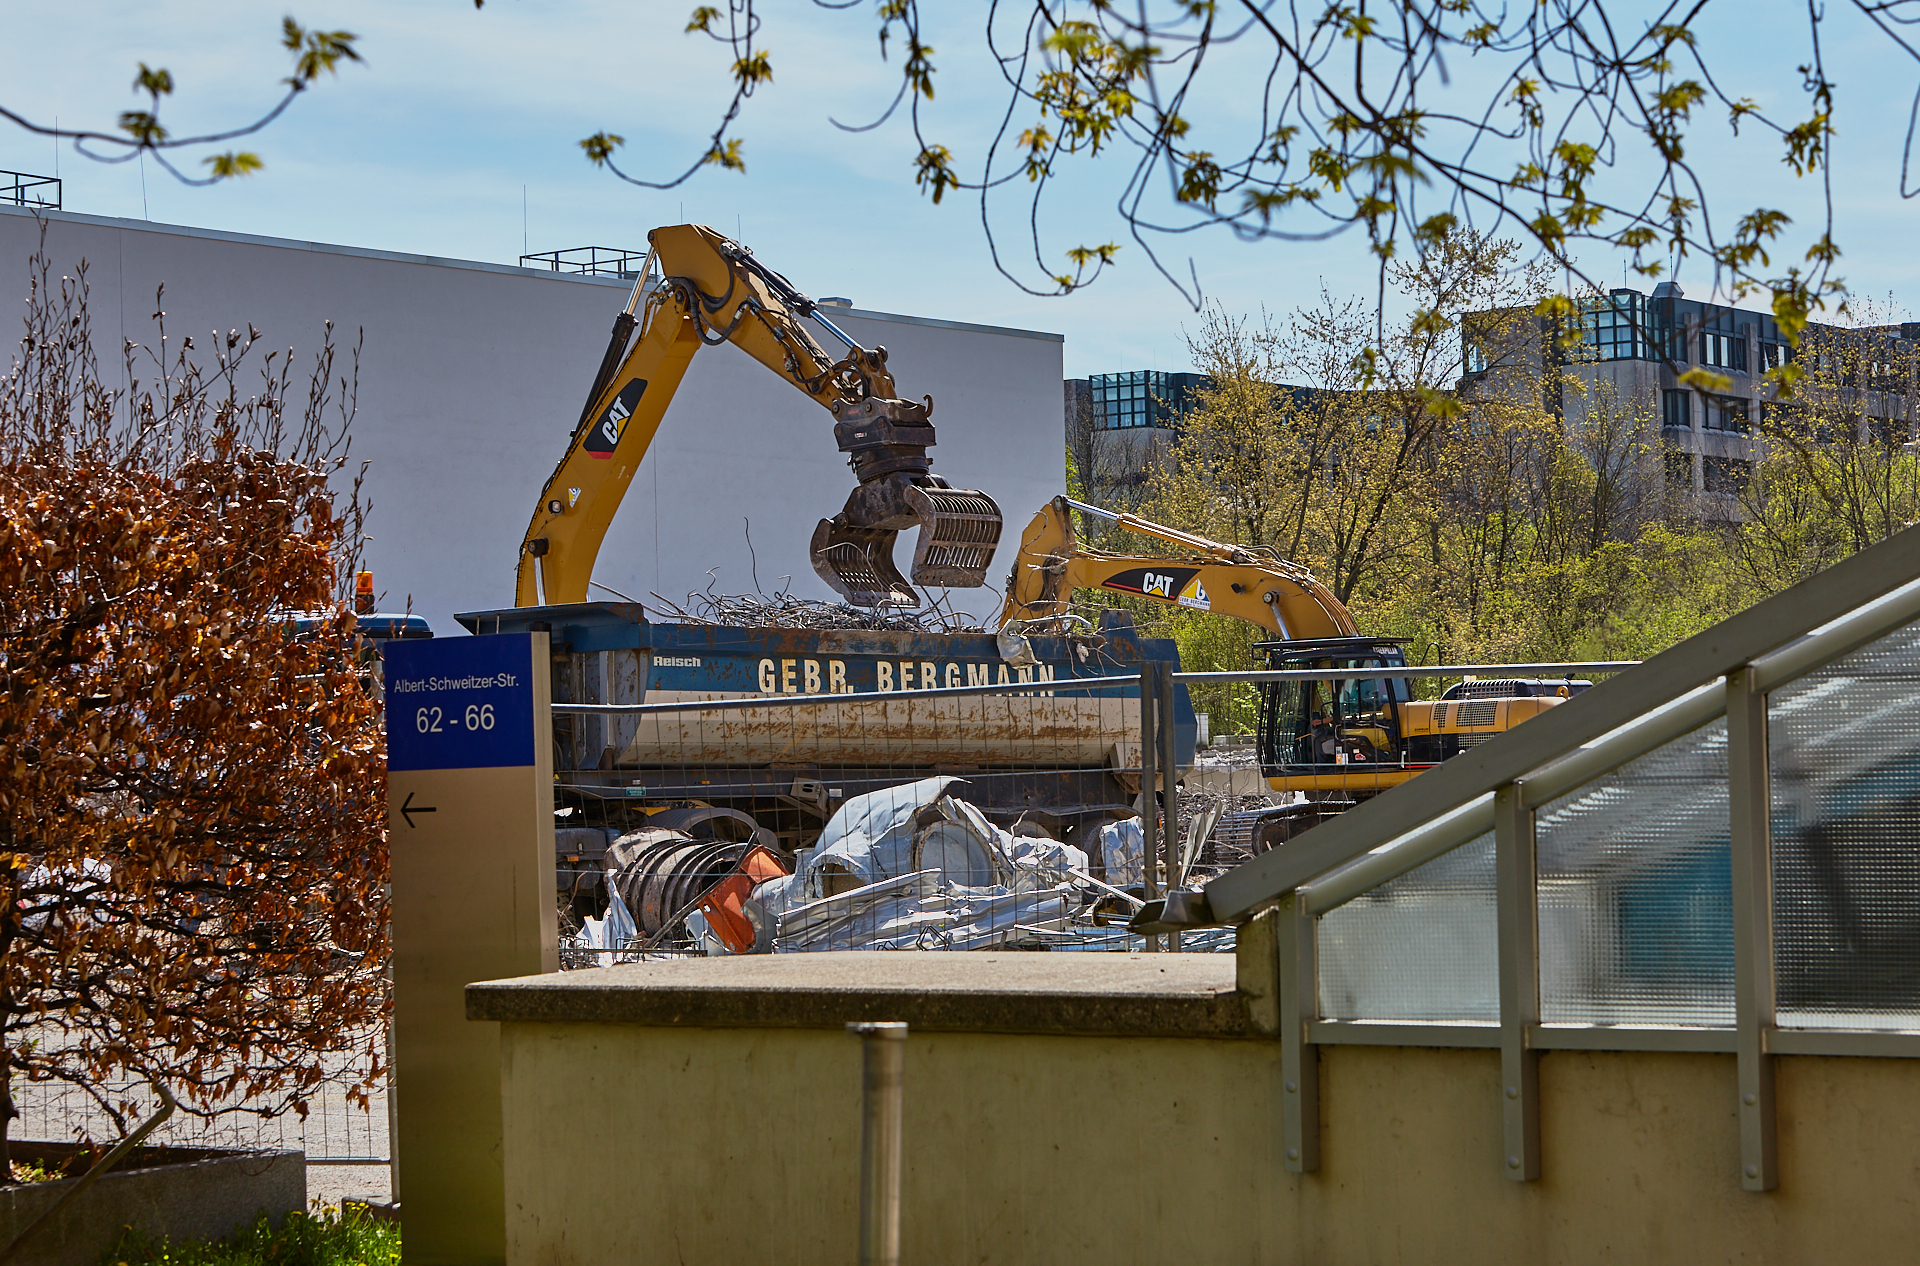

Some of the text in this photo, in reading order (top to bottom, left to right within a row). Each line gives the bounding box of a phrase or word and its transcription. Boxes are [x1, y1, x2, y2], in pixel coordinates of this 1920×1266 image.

[602, 395, 630, 445] CAT
[1142, 572, 1174, 598] CAT
[653, 656, 701, 667] Reisch
[394, 672, 519, 693] Albert-Schweitzer-Str.
[758, 658, 1055, 697] GEBR. BERGMANN
[416, 706, 443, 734] 62
[465, 703, 495, 731] 66
